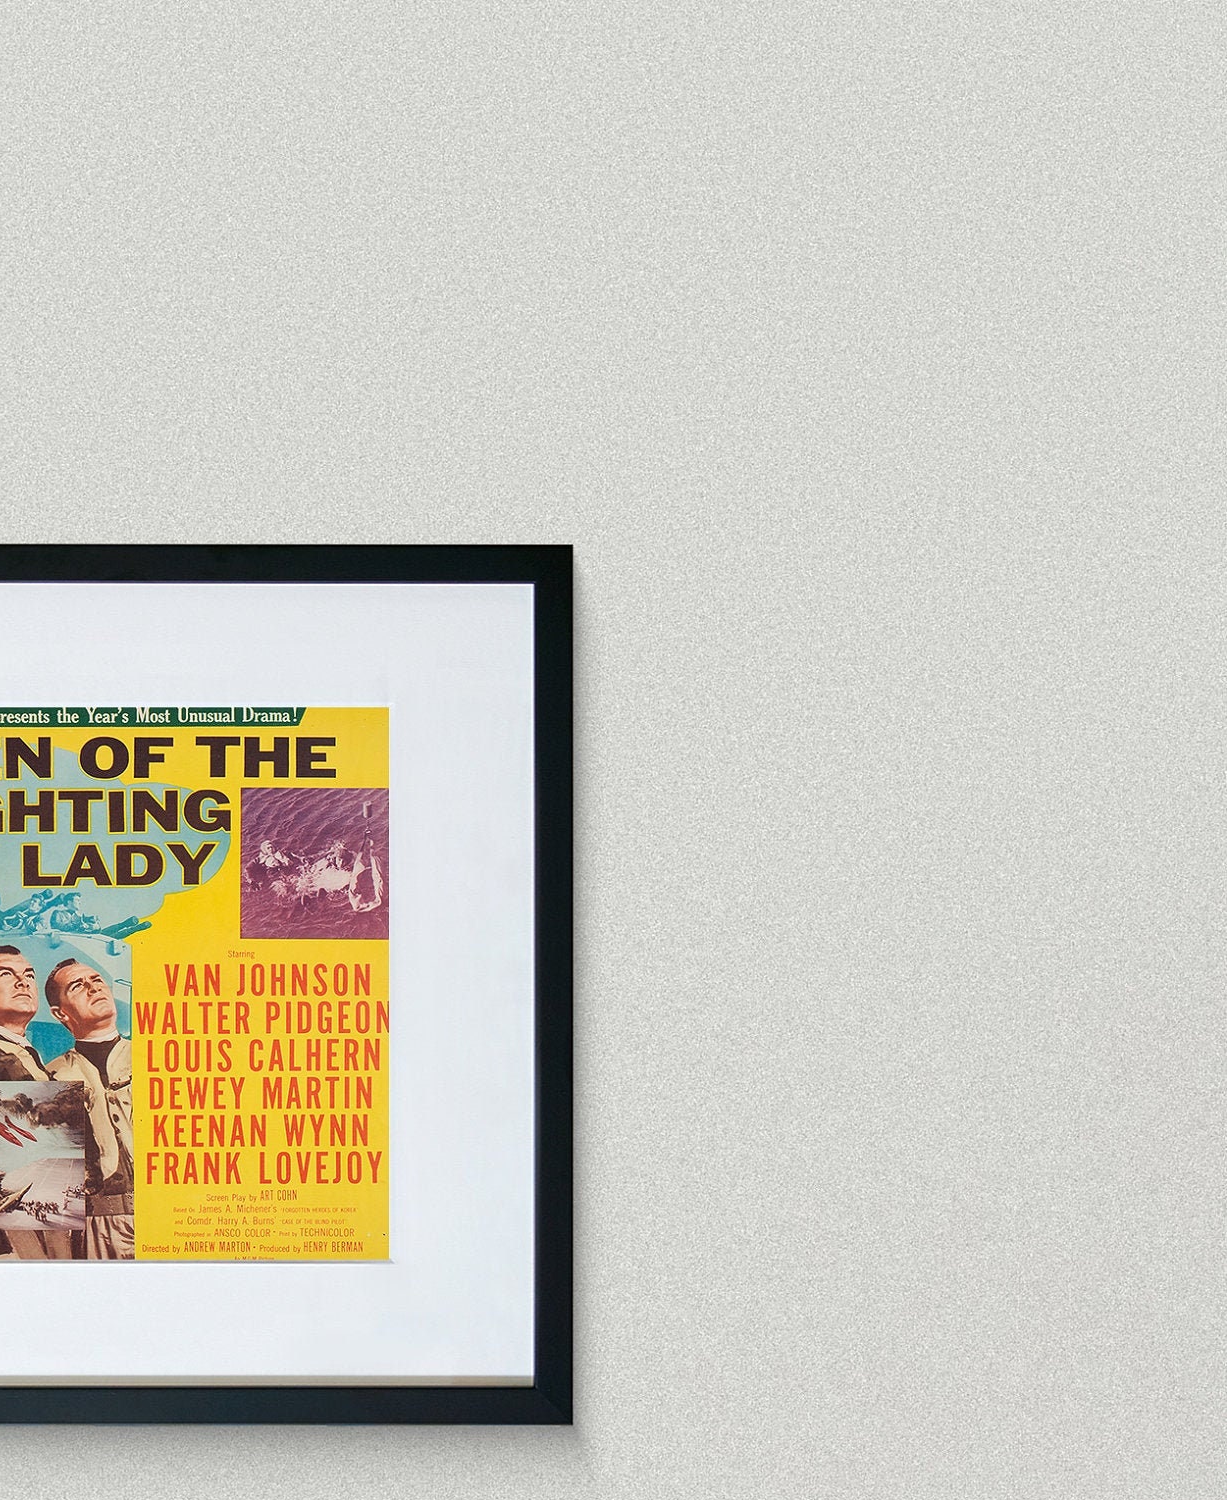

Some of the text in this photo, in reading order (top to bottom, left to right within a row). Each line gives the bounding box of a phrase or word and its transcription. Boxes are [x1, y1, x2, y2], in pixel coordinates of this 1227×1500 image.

[57, 708, 79, 723] the
[86, 708, 129, 723] Year's
[136, 708, 170, 723] Most
[177, 708, 235, 723] Unusual
[242, 708, 298, 723] Drama!
[78, 736, 174, 779] OF
[195, 736, 337, 779] THE
[22, 843, 218, 888] LADY
[227, 950, 255, 959] Starring
[164, 963, 371, 997] VAN JOHNSON
[135, 1001, 389, 1034] WALTER PIDGEON
[147, 1039, 380, 1072] LOUIS CALHERN
[149, 1077, 373, 1110] DEWEY MARTIN
[153, 1114, 368, 1147] KEENAN WYNN
[147, 1151, 382, 1185] FRANK LOVEJOY
[198, 1205, 222, 1213] James
[226, 1205, 232, 1213] A.
[237, 1205, 277, 1214] Michener's
[206, 1190, 297, 1203] Screen Play by ART COHN
[187, 1216, 214, 1225] Comdr.
[217, 1216, 239, 1226] Harry
[242, 1216, 250, 1225] A.
[214, 1229, 241, 1237] ANSCO
[245, 1228, 271, 1237] COLOR
[300, 1228, 355, 1237] TECHNICOLOR
[142, 1245, 170, 1253] Directed
[172, 1245, 180, 1253] by
[184, 1242, 215, 1252] ANDREW
[219, 1242, 251, 1252] MARTON
[293, 1244, 301, 1253] by
[303, 1242, 327, 1252] HENRY
[331, 1242, 363, 1252] BERMAN
